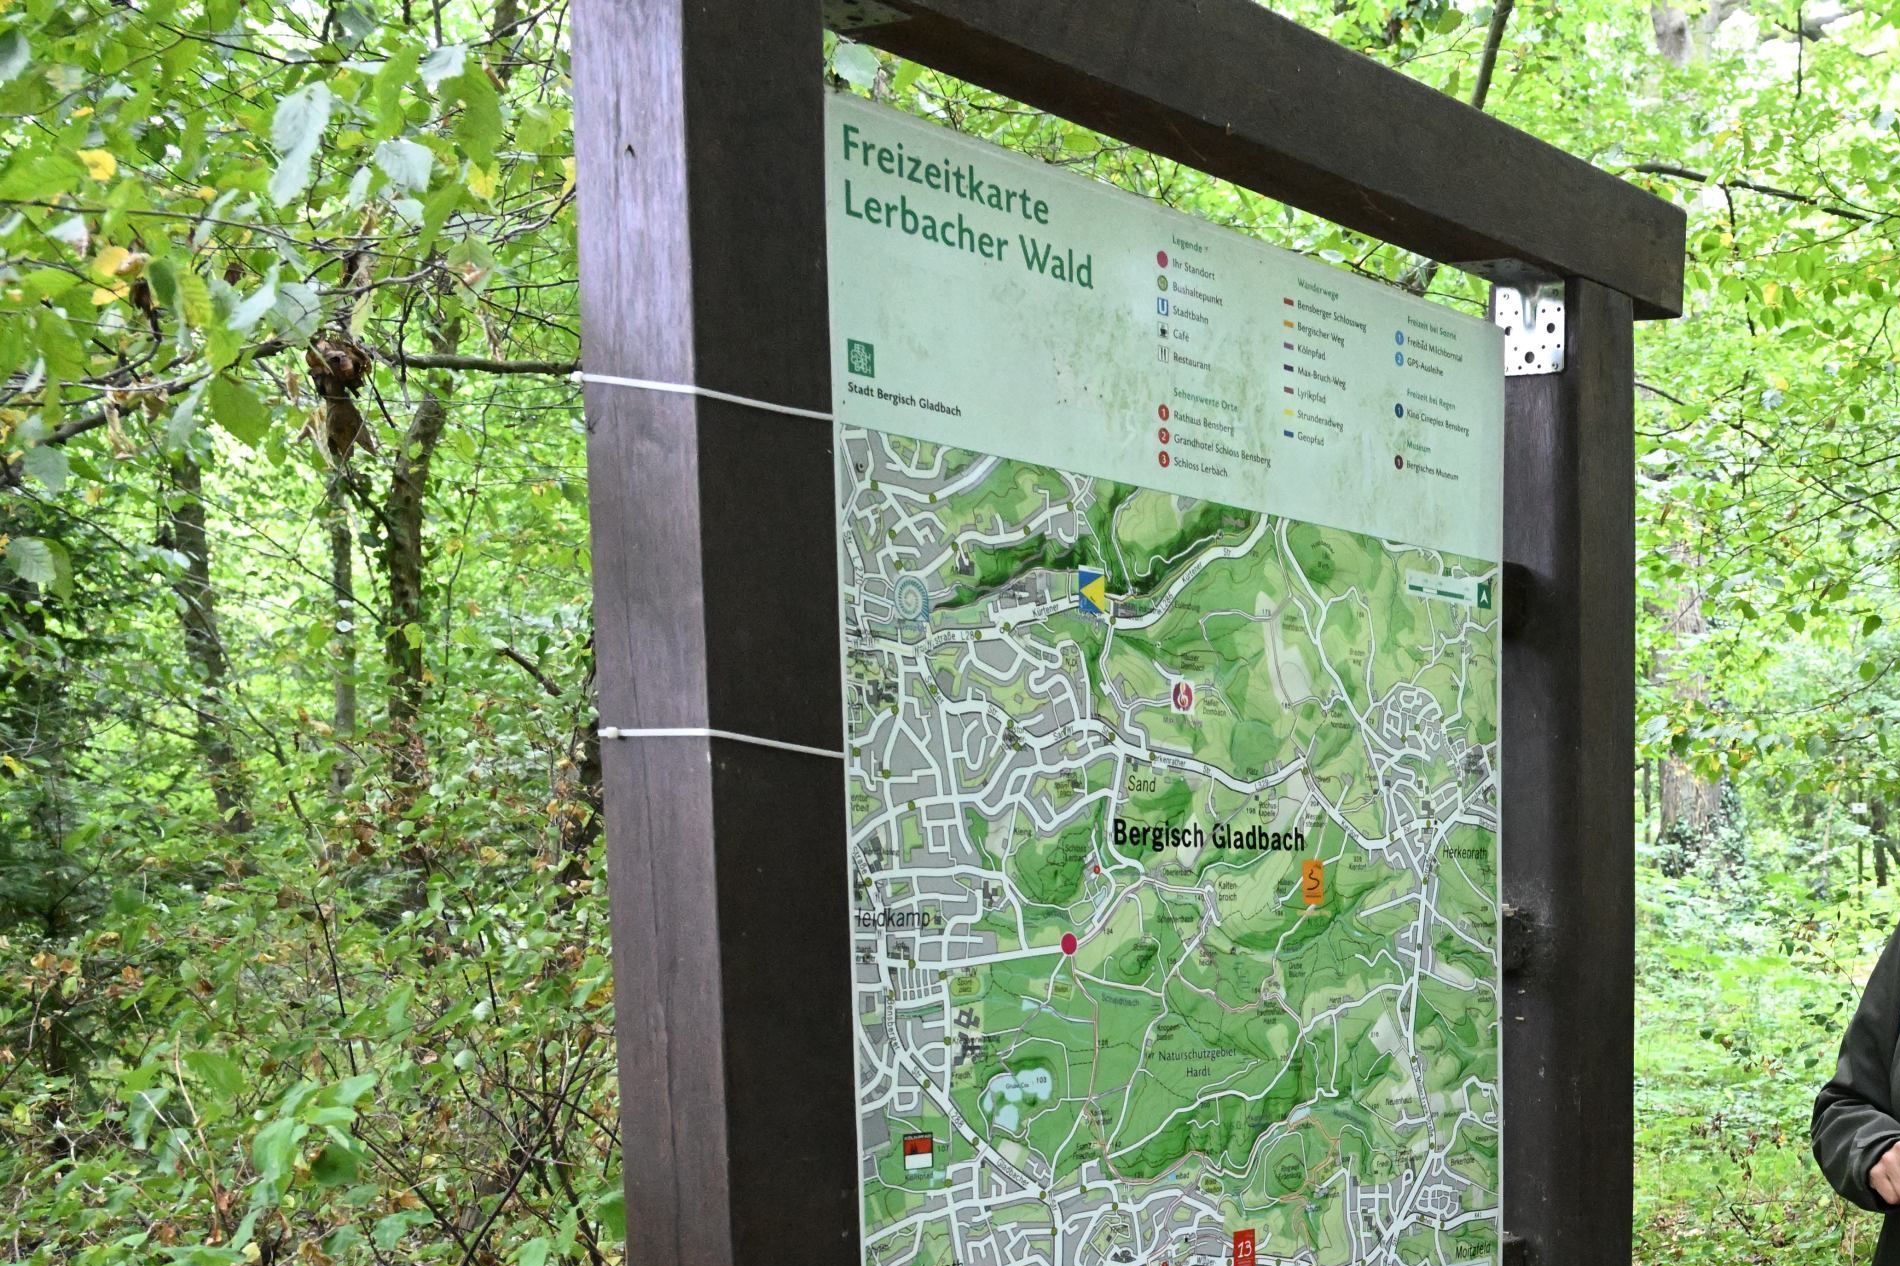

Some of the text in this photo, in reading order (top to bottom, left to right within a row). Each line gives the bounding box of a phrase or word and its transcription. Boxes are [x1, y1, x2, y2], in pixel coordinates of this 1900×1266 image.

[843, 123, 1049, 225] Freizeitkarte
[844, 179, 1093, 289] Lerbacher Wald
[1172, 234, 1202, 253] Legende
[1172, 258, 1216, 280] Ihr Standort
[1172, 281, 1223, 306] Bushaltepunkt
[1298, 277, 1339, 301] Wanderwege
[1173, 305, 1209, 324] Stadtbahn
[1298, 299, 1367, 334] Bensberger Schlossweg
[1298, 321, 1345, 348] Bergischer Weg
[1407, 315, 1429, 331] Freizeit
[1439, 327, 1457, 340] Sonne
[1173, 351, 1211, 371] Restaurant
[1298, 344, 1326, 360] Kölnpfad
[1298, 366, 1346, 391] Max-Bruch-Weg
[848, 382, 962, 416] Stadt Bergisch Gladbach
[1173, 387, 1238, 412] Sehenswerte Orte
[1298, 387, 1326, 404] Lyrikpfad
[1406, 387, 1456, 411] Freizeit bei Regen
[1173, 410, 1201, 426] Rathaus
[1203, 417, 1235, 437] Bensberg
[1297, 409, 1344, 432] Strunderadweg
[1406, 408, 1420, 420] Kino
[1445, 420, 1470, 437] Bensberg
[1173, 433, 1214, 452] Grandhotel
[1215, 443, 1240, 458] Schloss
[1241, 450, 1271, 468] Bensberg
[1298, 431, 1325, 447] Geopfad
[1173, 457, 1200, 471] Schloss
[1201, 463, 1228, 477] Lerbach
[1406, 460, 1435, 474] Bergisches
[1435, 467, 1459, 480] Museum
[1032, 603, 1059, 617] Kürtener
[1127, 774, 1156, 793] Sand
[1114, 818, 1305, 852] Bergisch Gladbach
[852, 846, 868, 875] Straße
[1443, 845, 1488, 860] Herkenrath
[1158, 1046, 1237, 1062] Naturschutzgebiet
[1186, 1066, 1211, 1078] Hardt
[997, 1158, 1029, 1187] Gladbacher
[1236, 1240, 1253, 1258] 13
[1455, 1244, 1491, 1259] Moitzfeld
